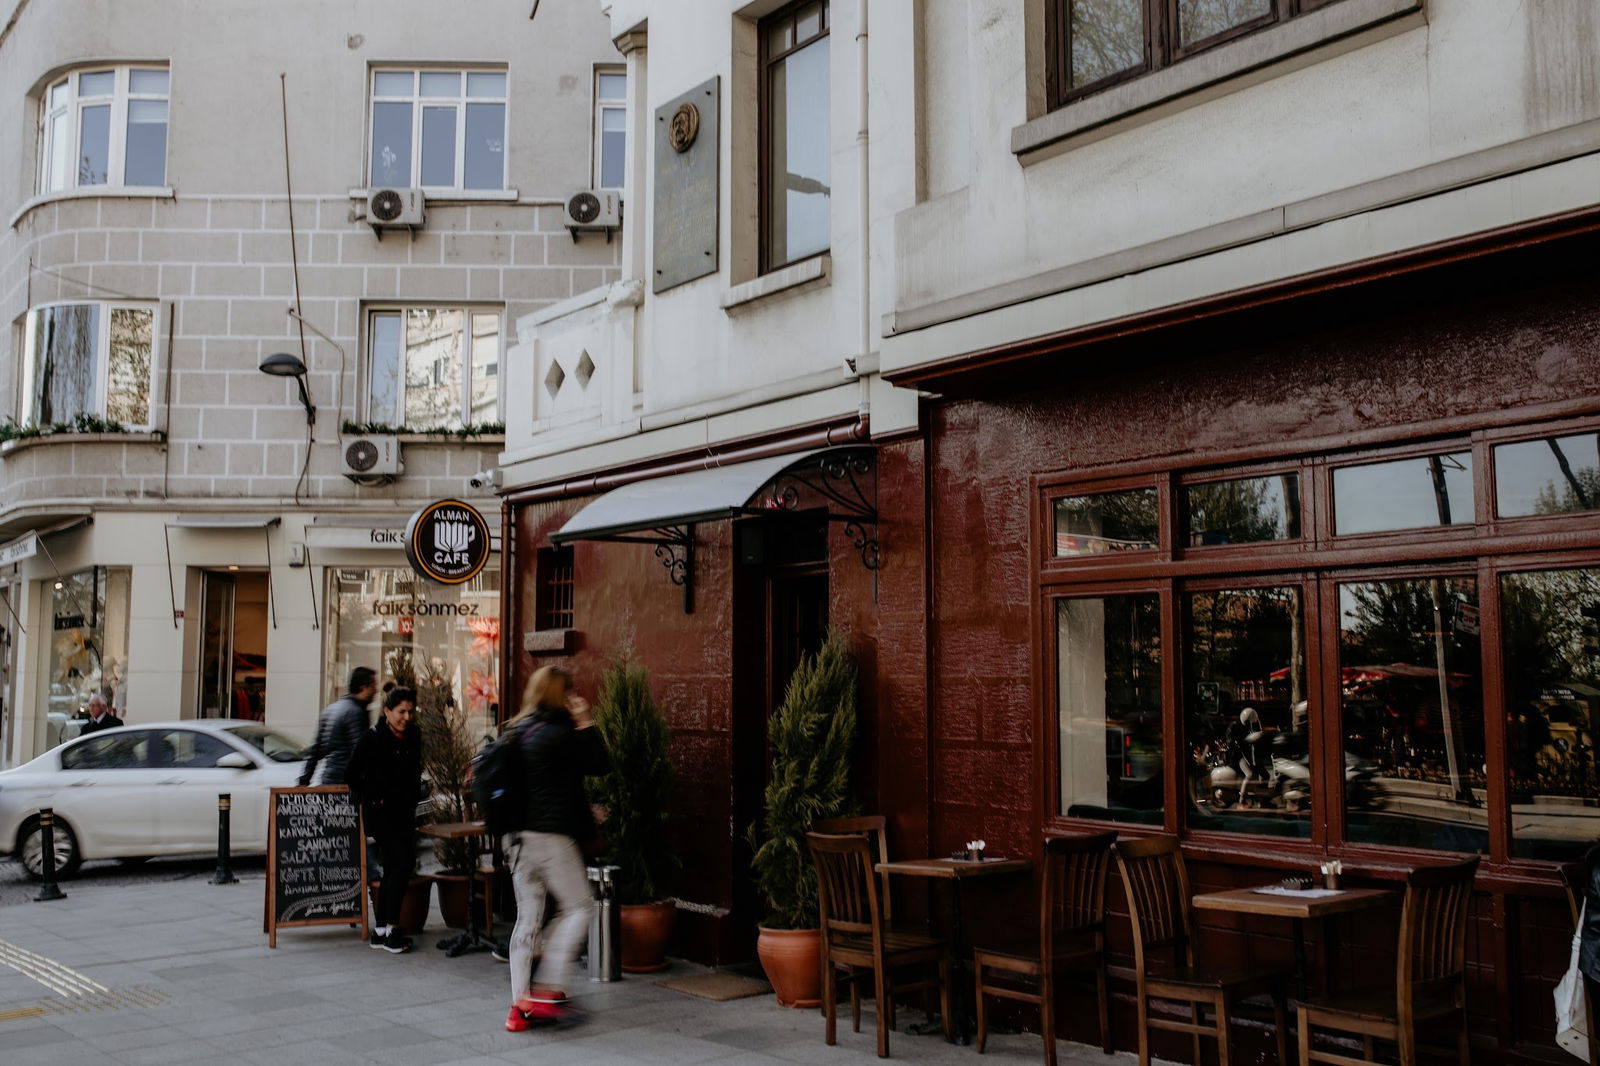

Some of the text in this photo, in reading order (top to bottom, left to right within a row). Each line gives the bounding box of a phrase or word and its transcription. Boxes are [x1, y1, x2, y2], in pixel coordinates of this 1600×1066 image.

[433, 509, 470, 522] ALMAN
[370, 529, 396, 543] faik
[434, 551, 469, 564] CAFE
[373, 600, 480, 616] faik sönmez
